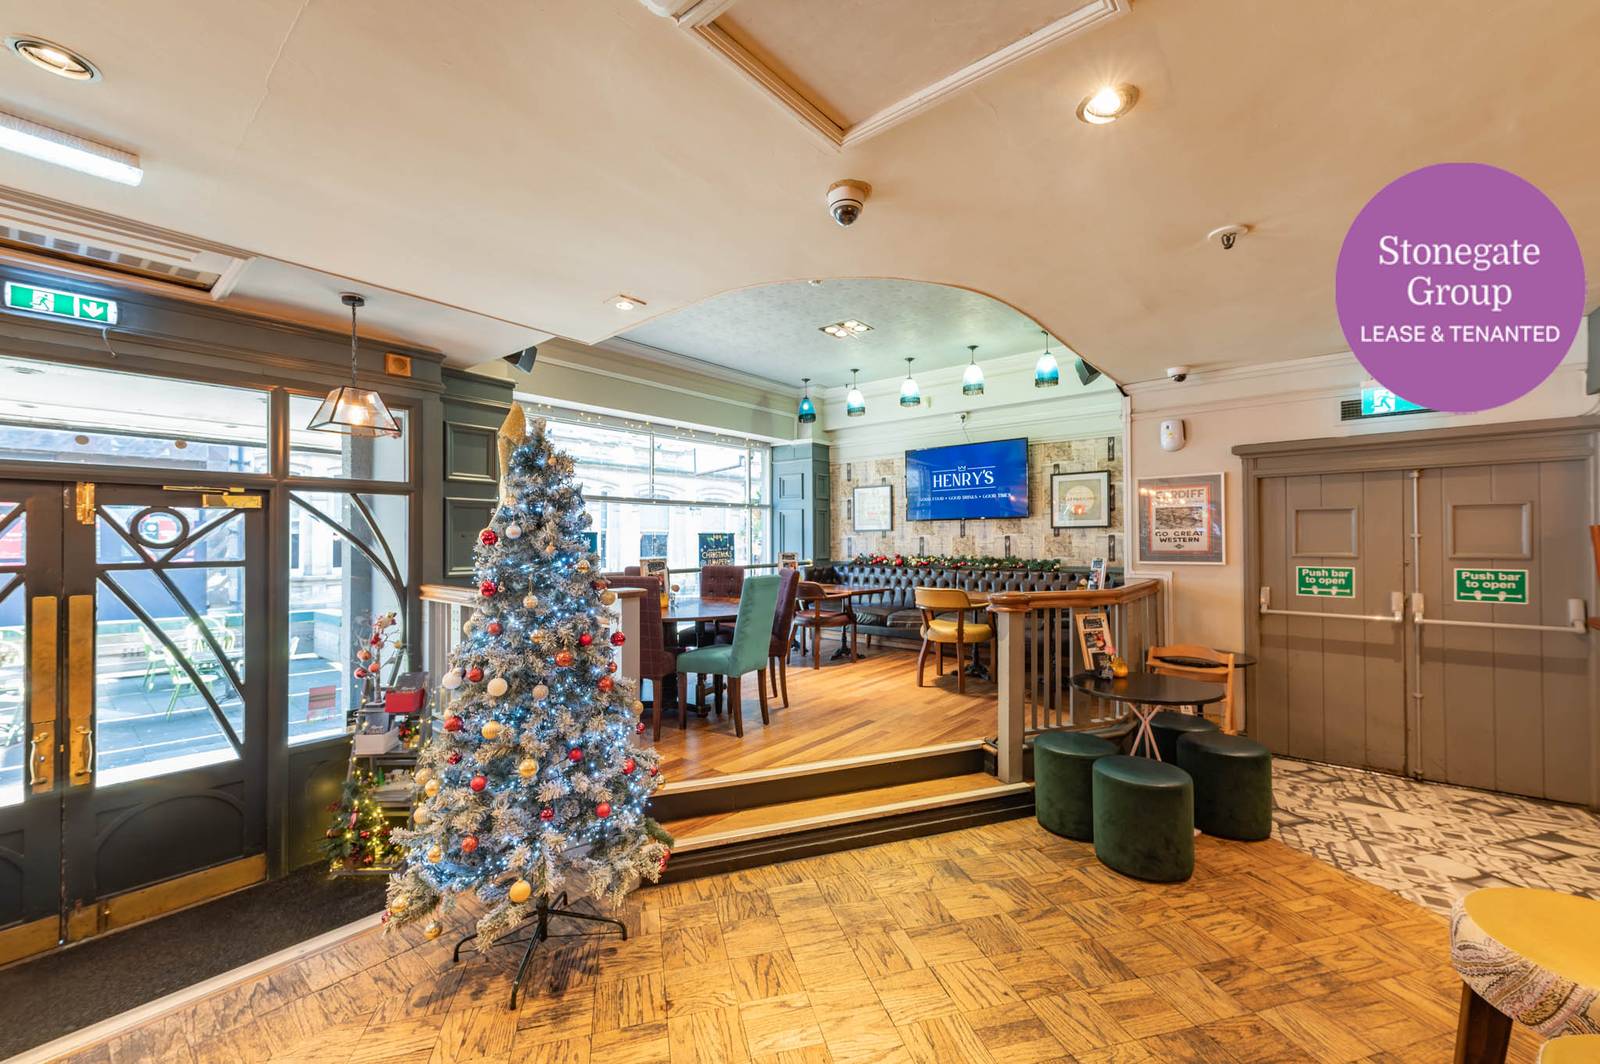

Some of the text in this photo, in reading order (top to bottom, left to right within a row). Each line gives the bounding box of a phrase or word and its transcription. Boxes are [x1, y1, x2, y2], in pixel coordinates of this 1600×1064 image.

[933, 470, 994, 488] HENRY'S
[1155, 489, 1205, 499] CRDIFF
[1302, 569, 1350, 578] Push bar
[1462, 571, 1522, 581] Push bar
[1306, 576, 1345, 586] to open
[1466, 580, 1516, 590] to open
